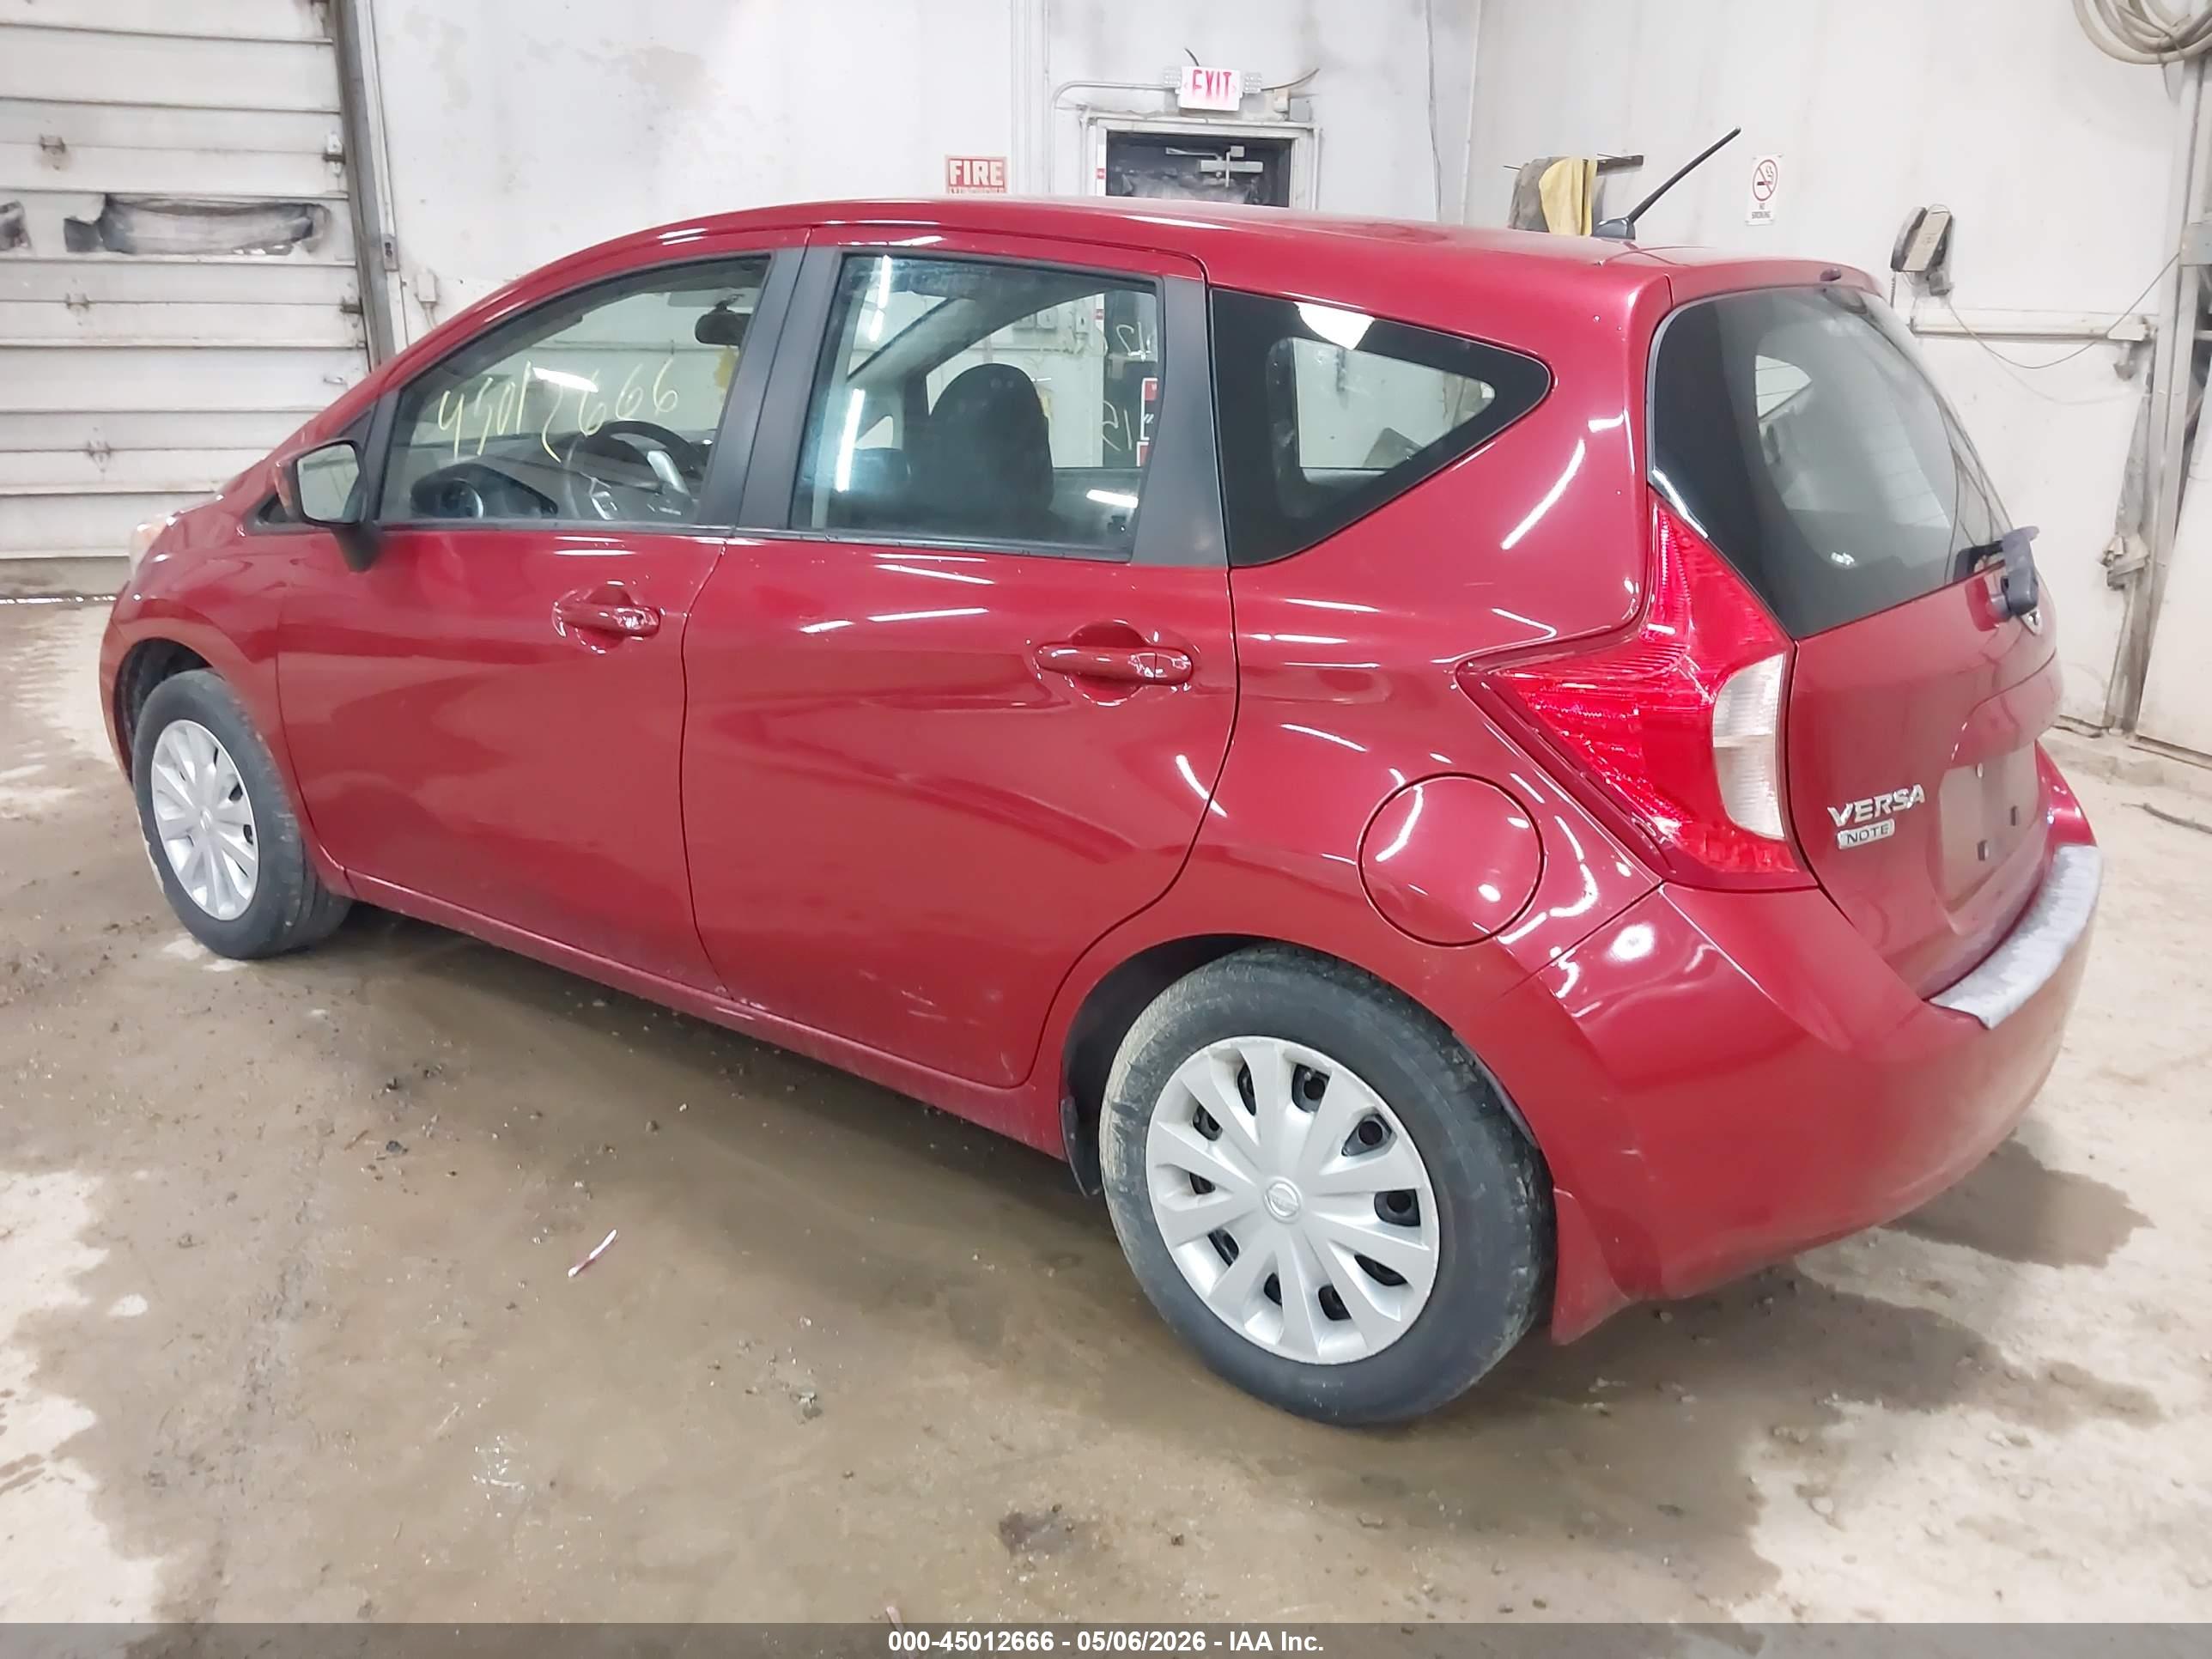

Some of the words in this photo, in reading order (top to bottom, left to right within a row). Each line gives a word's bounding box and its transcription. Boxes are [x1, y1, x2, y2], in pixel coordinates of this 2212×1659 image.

[1192, 70, 1232, 98] EXIT
[949, 160, 1004, 186] FIRE
[1826, 783, 1925, 827] VERSA
[1846, 823, 1889, 844] NOTE
